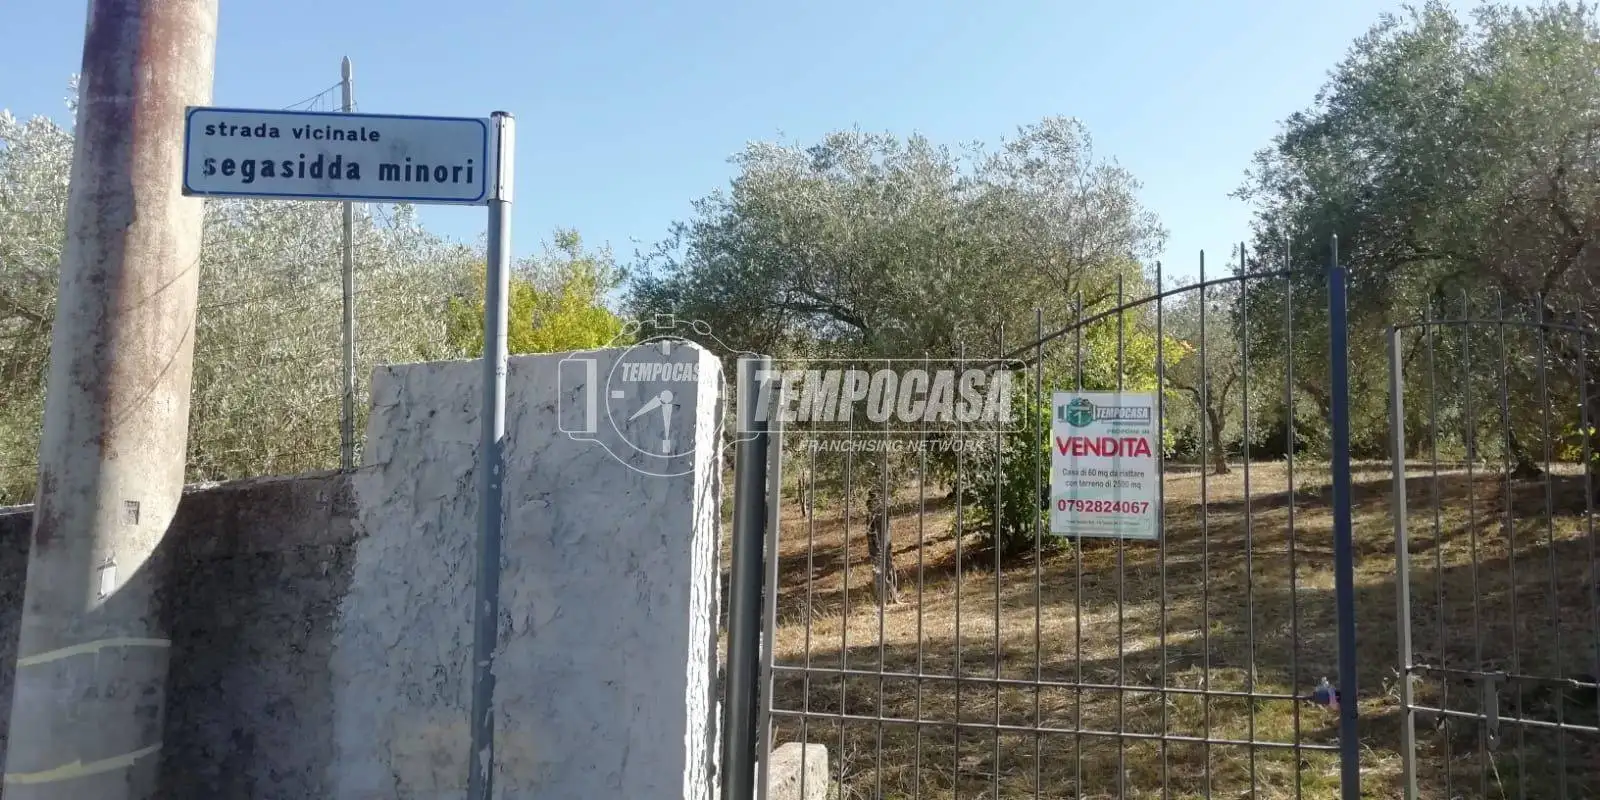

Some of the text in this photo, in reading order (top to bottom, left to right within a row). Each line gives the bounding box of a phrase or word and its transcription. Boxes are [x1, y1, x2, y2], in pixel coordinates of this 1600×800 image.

[204, 121, 381, 142] strada vicinale
[203, 153, 474, 184] segasidda minori
[1096, 407, 1148, 419] TEMPOCASA
[1055, 436, 1151, 457] VENDITA
[1062, 468, 1079, 477] Casa
[1080, 468, 1087, 477] di
[1097, 470, 1109, 479] mq
[1057, 499, 1149, 514] 0792824067
